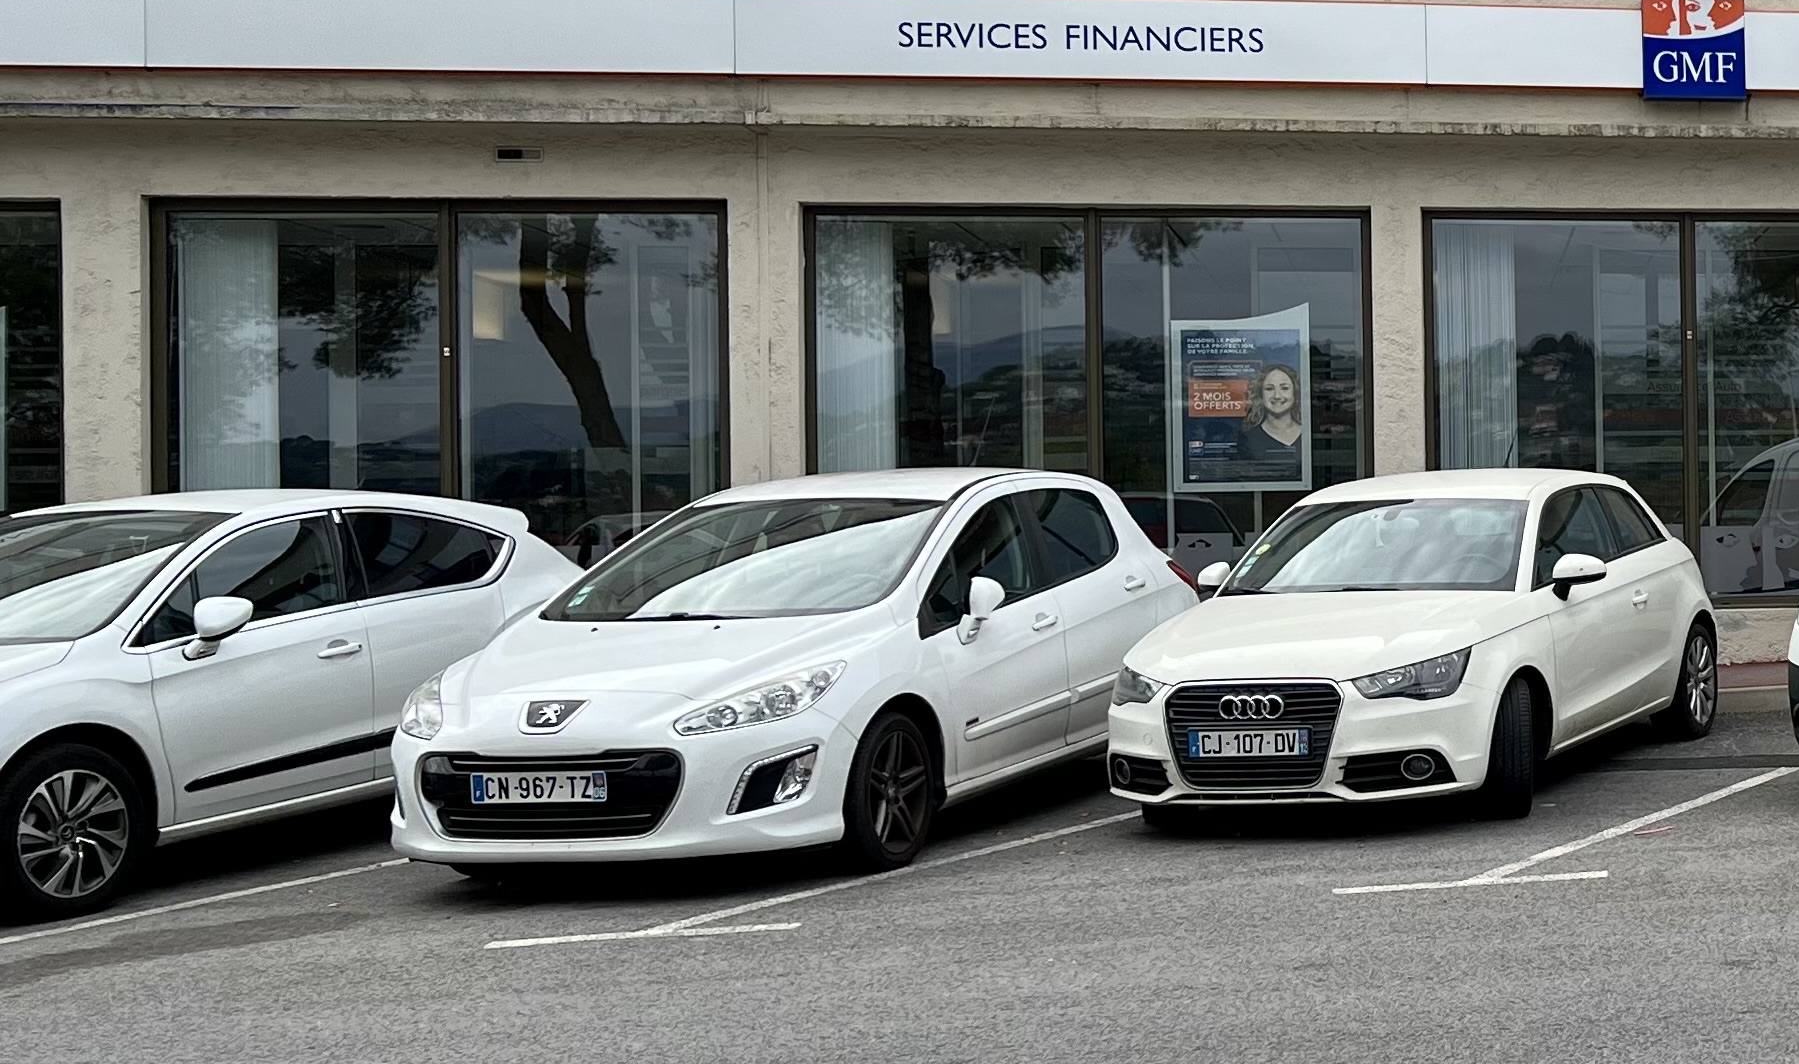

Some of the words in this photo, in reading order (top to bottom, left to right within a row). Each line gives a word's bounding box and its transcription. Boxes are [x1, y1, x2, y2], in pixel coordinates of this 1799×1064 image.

[897, 21, 1048, 50] SERVICES
[1065, 24, 1264, 53] FINANCIERS
[1653, 50, 1737, 83] GMF
[1194, 392, 1200, 401] 2
[1203, 392, 1231, 401] MOIS
[1194, 401, 1241, 410] OFFERTS
[1201, 733, 1296, 754] CJ-107-DV
[484, 776, 592, 800] CN-967-TZ
[593, 787, 606, 799] 06
